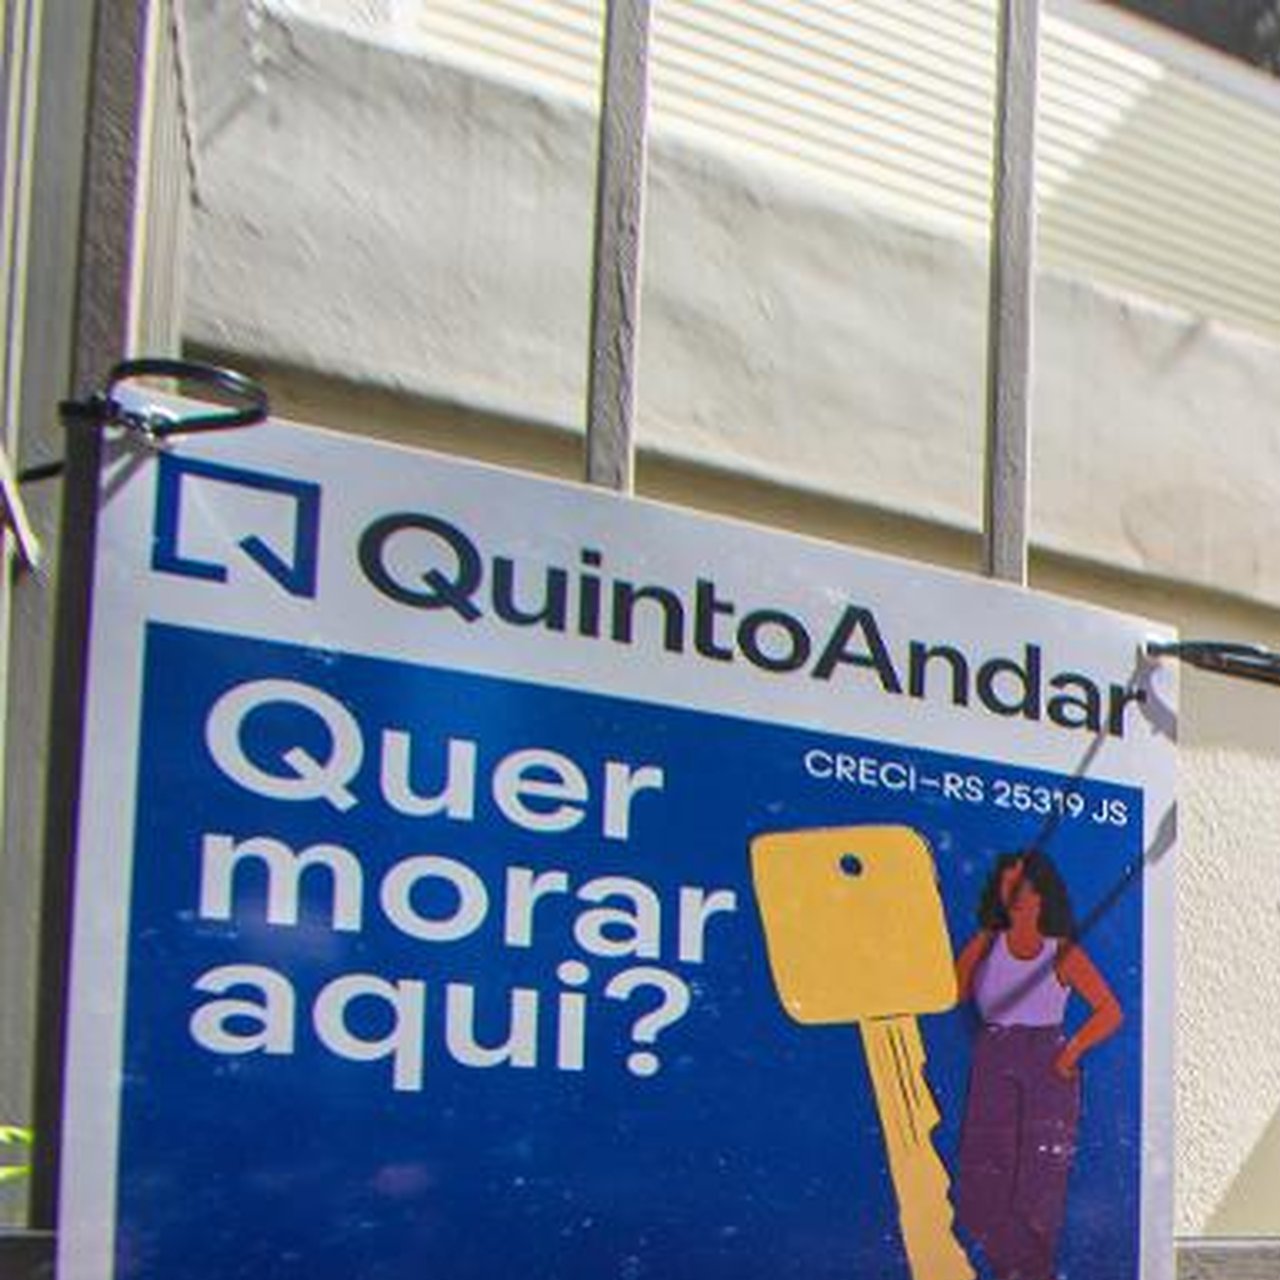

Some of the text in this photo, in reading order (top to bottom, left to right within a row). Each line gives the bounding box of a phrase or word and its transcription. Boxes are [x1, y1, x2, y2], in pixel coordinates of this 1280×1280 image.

[357, 512, 1147, 738] QuintoAndar
[204, 678, 665, 840] Quer
[804, 748, 985, 802] CRECI-RS
[1092, 800, 1128, 826] JS
[200, 833, 737, 965] morar
[188, 960, 693, 1092] aqui?
